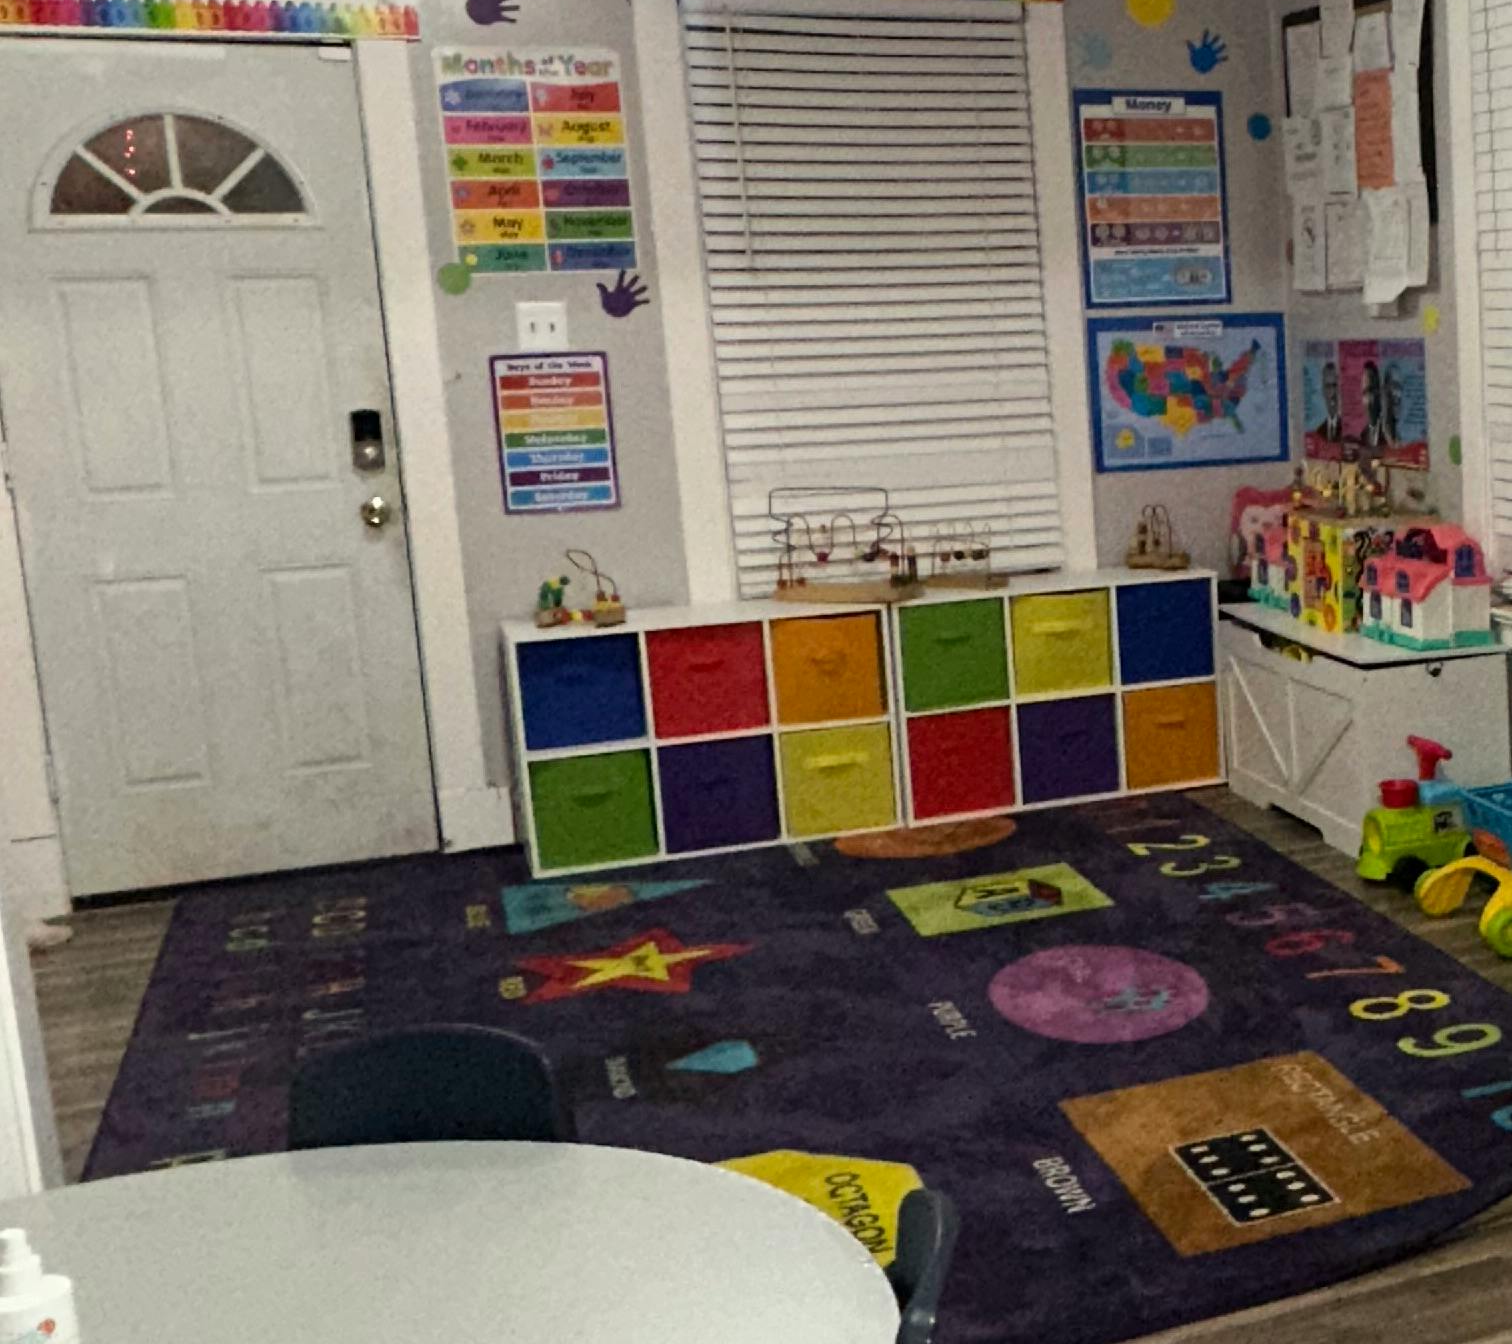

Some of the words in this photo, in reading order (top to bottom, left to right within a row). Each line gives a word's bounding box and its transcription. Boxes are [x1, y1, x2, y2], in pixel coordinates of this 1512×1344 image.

[441, 52, 536, 76] Months
[559, 54, 613, 76] Year
[569, 88, 595, 103] July
[1124, 98, 1172, 112] Money
[466, 119, 527, 135] February
[561, 120, 611, 135] August
[477, 152, 524, 165] March
[555, 152, 622, 165] September
[488, 184, 522, 199] April
[492, 217, 523, 230] May
[527, 375, 573, 388] Sunday
[1126, 834, 1211, 856] 2
[1159, 856, 1242, 877] 3
[1264, 928, 1356, 959] 6
[1305, 954, 1407, 980] 7
[1349, 988, 1450, 1020] 8
[1396, 1023, 1503, 1058] 9
[1032, 1156, 1097, 1215] BROWN
[824, 1171, 893, 1254] OCTAGON
